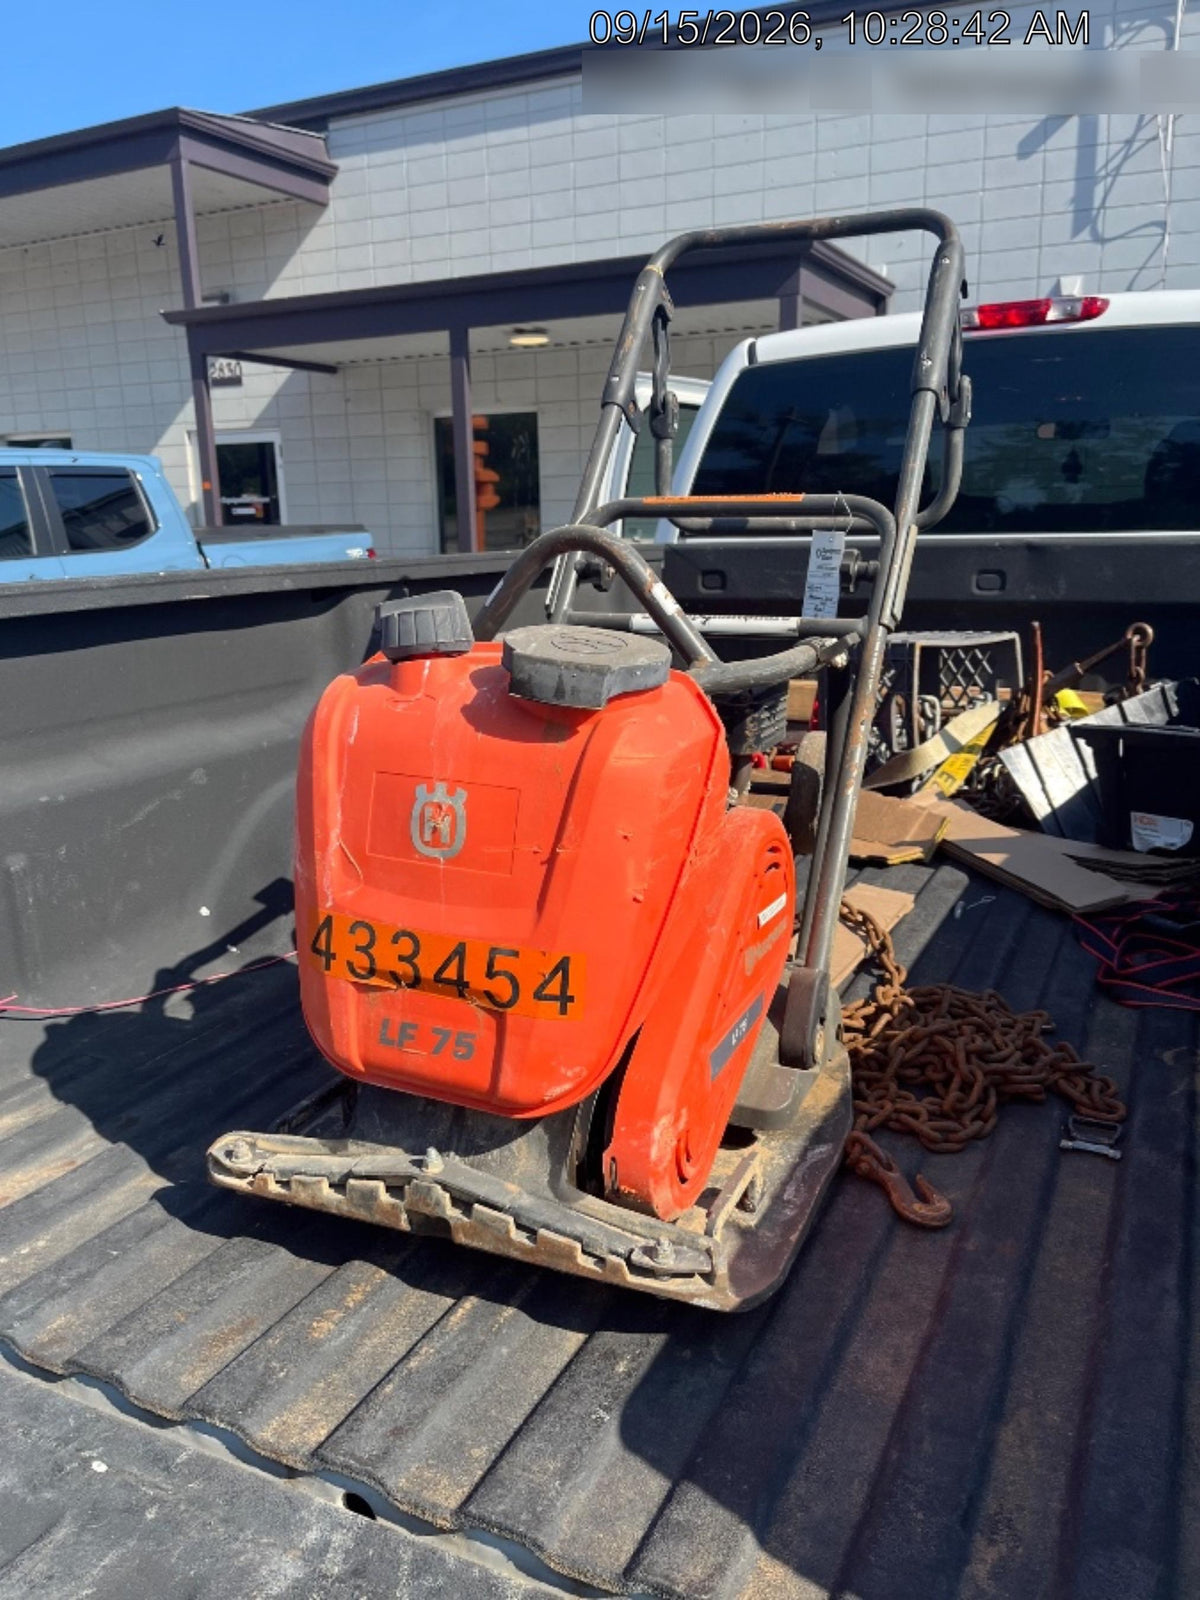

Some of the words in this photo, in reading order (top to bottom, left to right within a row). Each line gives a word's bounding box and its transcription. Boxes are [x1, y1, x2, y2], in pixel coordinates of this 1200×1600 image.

[310, 914, 575, 1015] 433454
[378, 1018, 419, 1048] LF
[431, 1027, 477, 1061] 75
